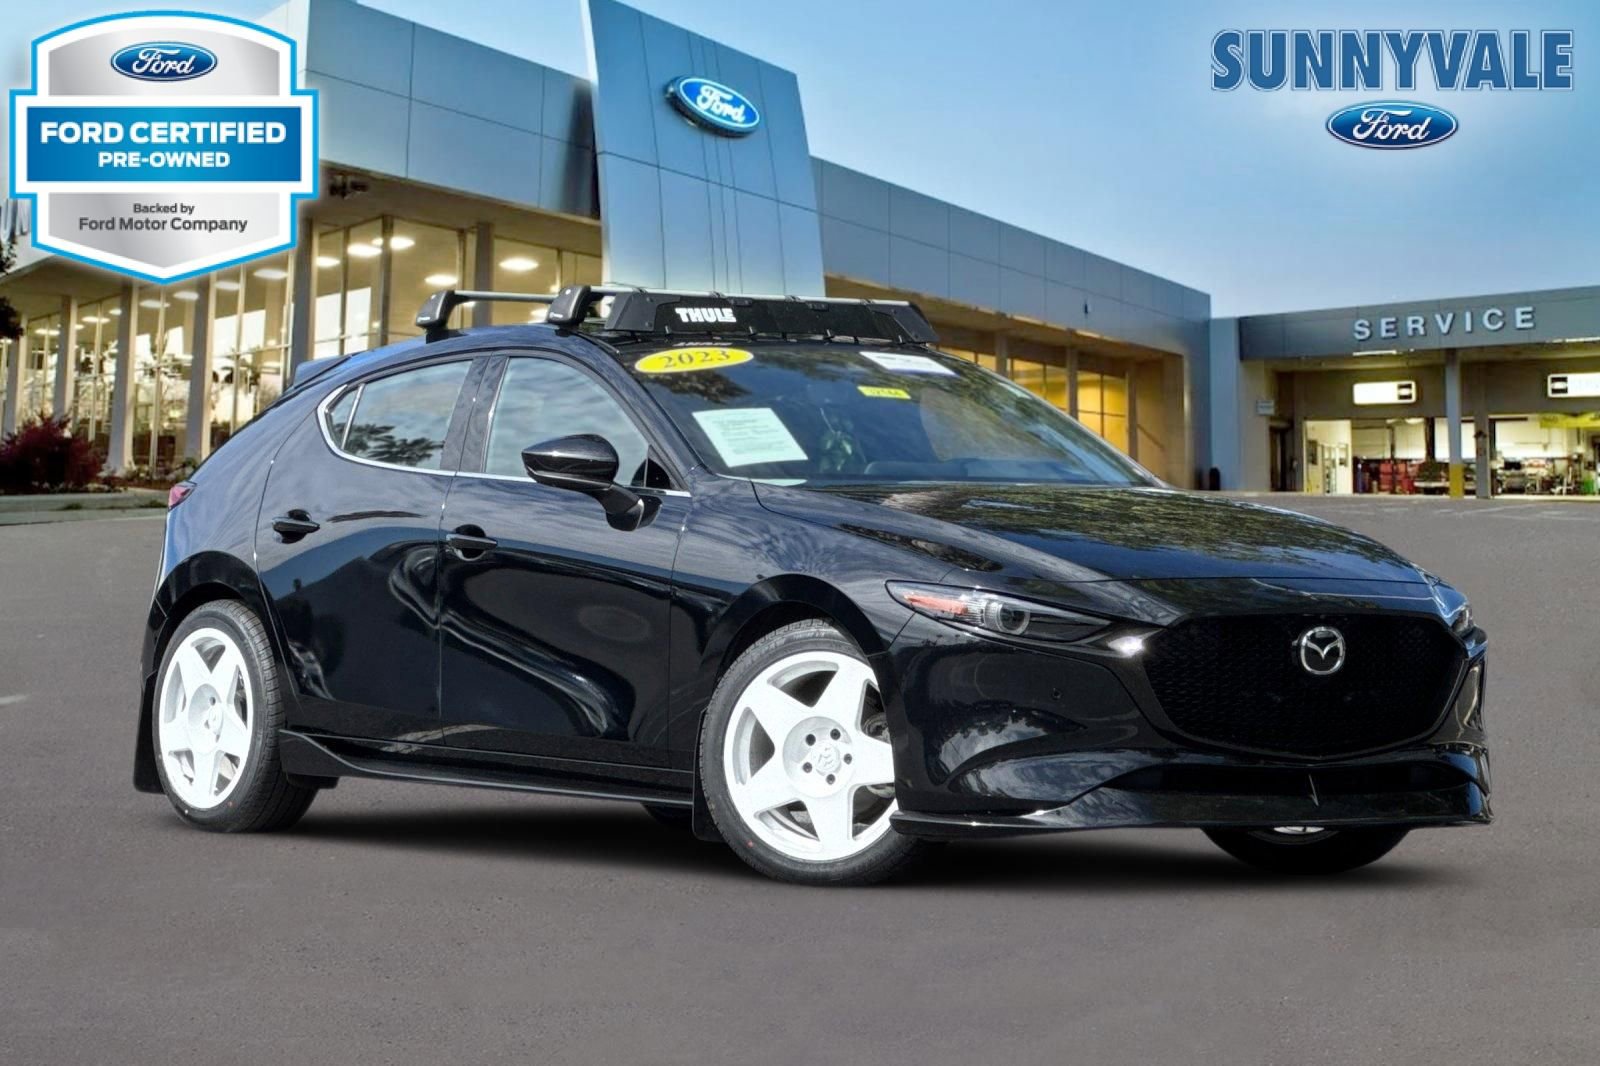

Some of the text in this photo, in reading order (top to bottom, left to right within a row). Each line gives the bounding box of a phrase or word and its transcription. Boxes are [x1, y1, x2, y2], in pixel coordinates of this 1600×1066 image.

[696, 85, 746, 122] Ford
[674, 307, 737, 323] THULE
[1353, 306, 1535, 341] SERVICE
[659, 350, 730, 368] 2023
